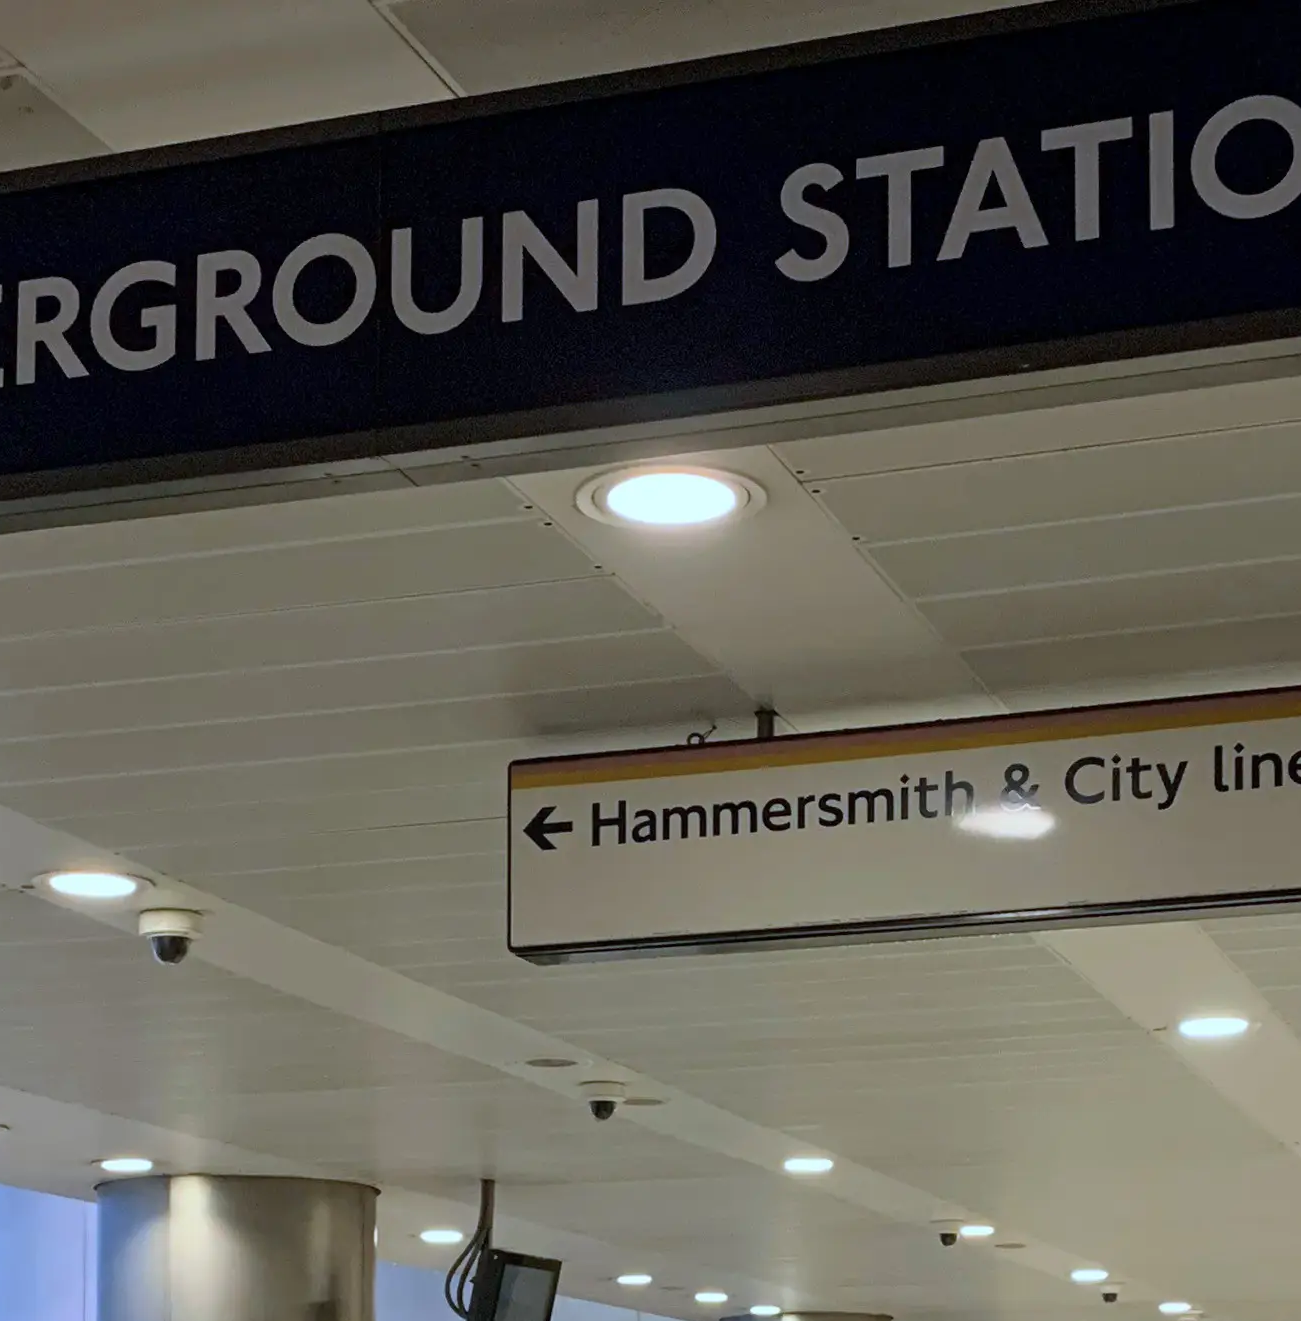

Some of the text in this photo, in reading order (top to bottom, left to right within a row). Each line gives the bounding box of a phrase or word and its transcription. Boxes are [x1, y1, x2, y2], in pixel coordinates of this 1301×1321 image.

[591, 769, 975, 847] Hammersmith
[999, 763, 1042, 811] &
[1064, 752, 1189, 811] City
